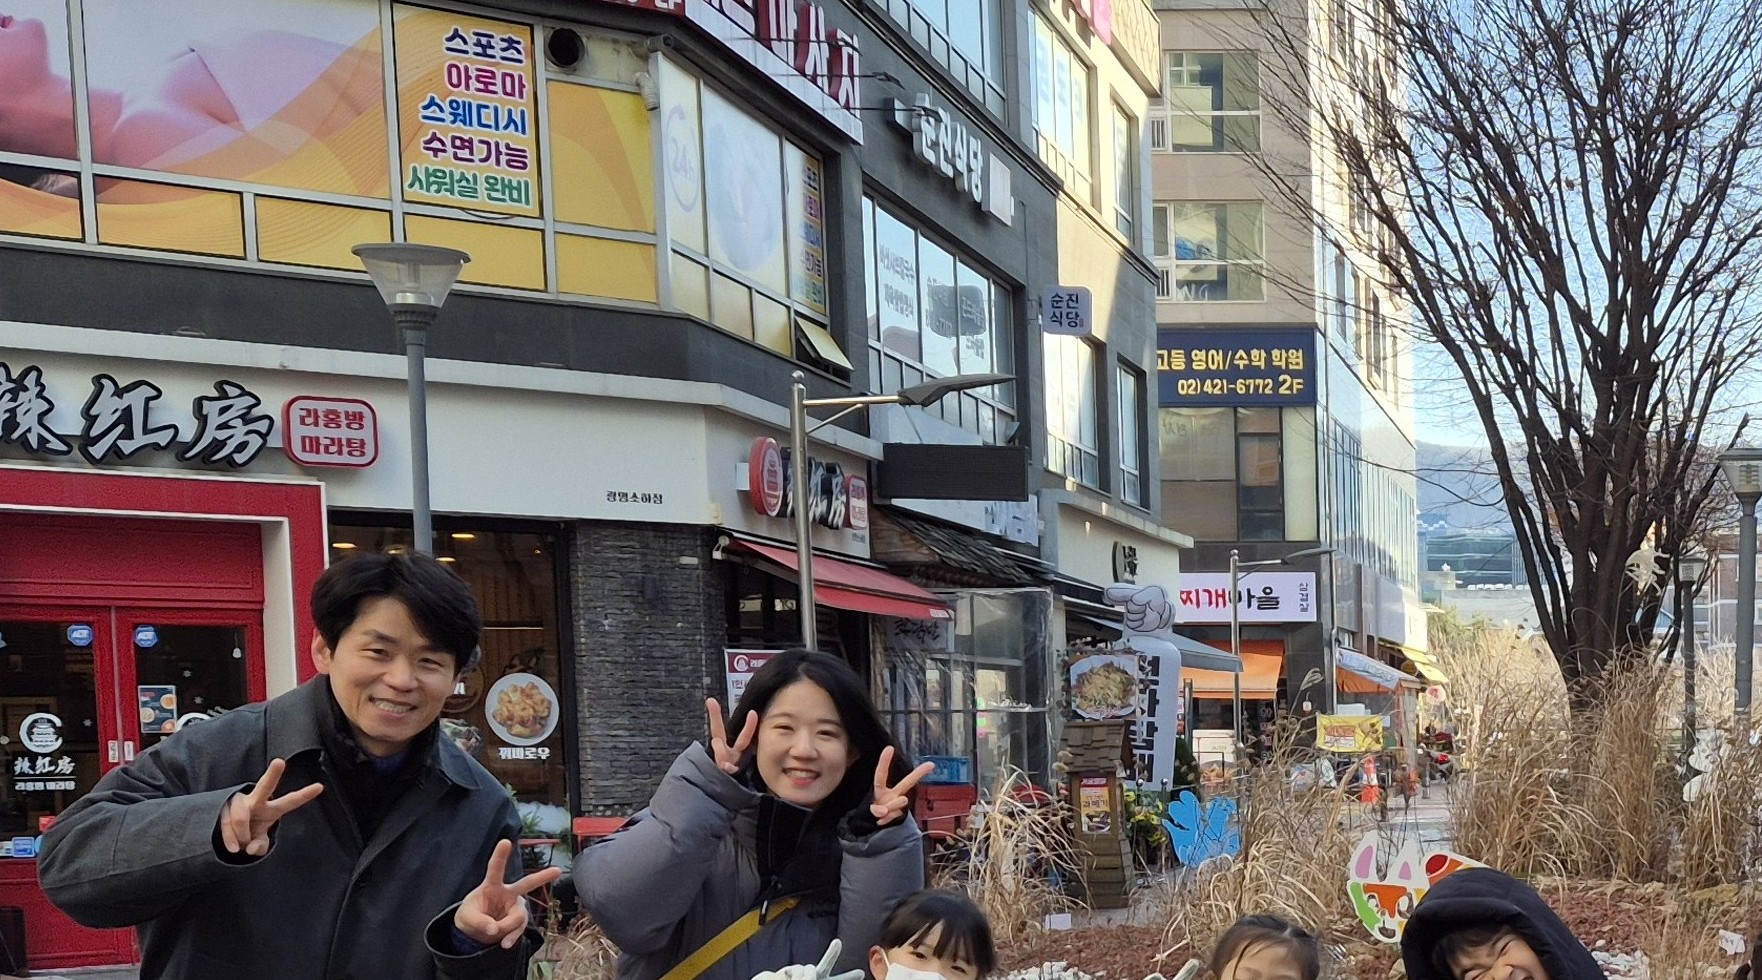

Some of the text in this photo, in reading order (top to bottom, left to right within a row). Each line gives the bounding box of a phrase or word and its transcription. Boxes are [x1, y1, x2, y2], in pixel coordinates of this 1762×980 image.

[444, 26, 525, 65] 스포츠
[446, 62, 527, 100] 아로마
[420, 94, 527, 136] 스웨디시
[422, 131, 529, 171] 수면가능
[407, 164, 531, 207] 샤워실 완비
[1050, 292, 1080, 310] 순진
[1050, 309, 1080, 329] 식당
[1157, 348, 1304, 371] 고등 영어/수학 학원
[1177, 374, 1304, 395] 02)421-6772 2F
[298, 407, 366, 431] 라홍방
[299, 434, 368, 459] 마라탕
